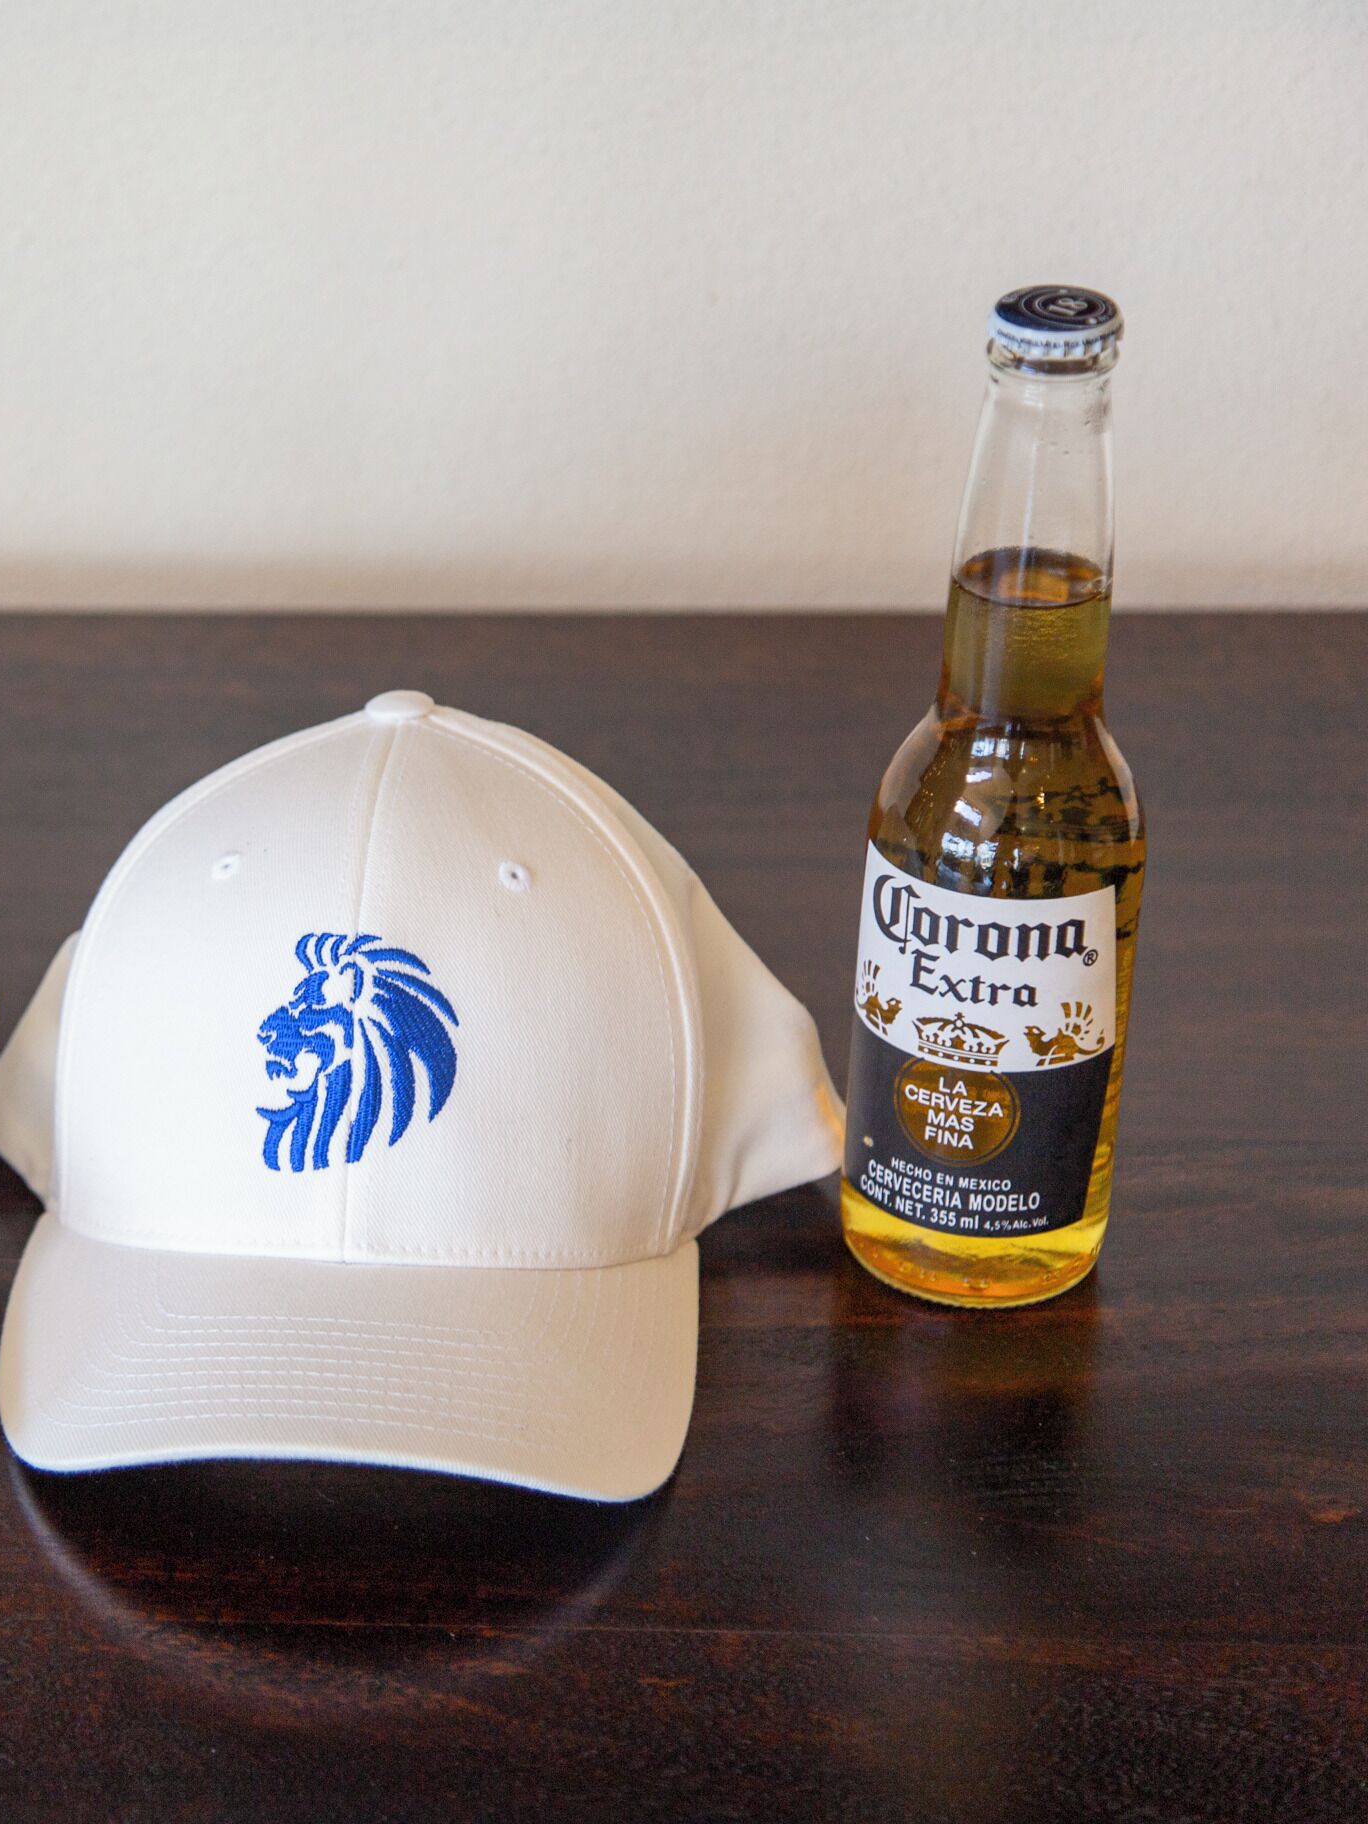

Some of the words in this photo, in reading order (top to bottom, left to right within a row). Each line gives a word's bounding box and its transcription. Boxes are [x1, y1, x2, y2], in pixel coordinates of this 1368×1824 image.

[873, 874, 1088, 962] Corona
[910, 949, 1039, 1008] Extra
[904, 1084, 1004, 1118] CERVEZA
[939, 1076, 967, 1096] LA
[927, 1109, 975, 1132] MAS
[924, 1127, 974, 1150] FINA
[868, 1159, 962, 1209] CERVECERIA
[969, 1192, 1040, 1212] MODELO
[891, 1157, 932, 1181] HECHO
[936, 1173, 955, 1186] EN
[958, 1177, 1011, 1191] MEXICO
[860, 1174, 892, 1207] CONT.
[895, 1196, 926, 1220] NET.
[930, 1208, 957, 1227] 355
[960, 1215, 979, 1230] ml
